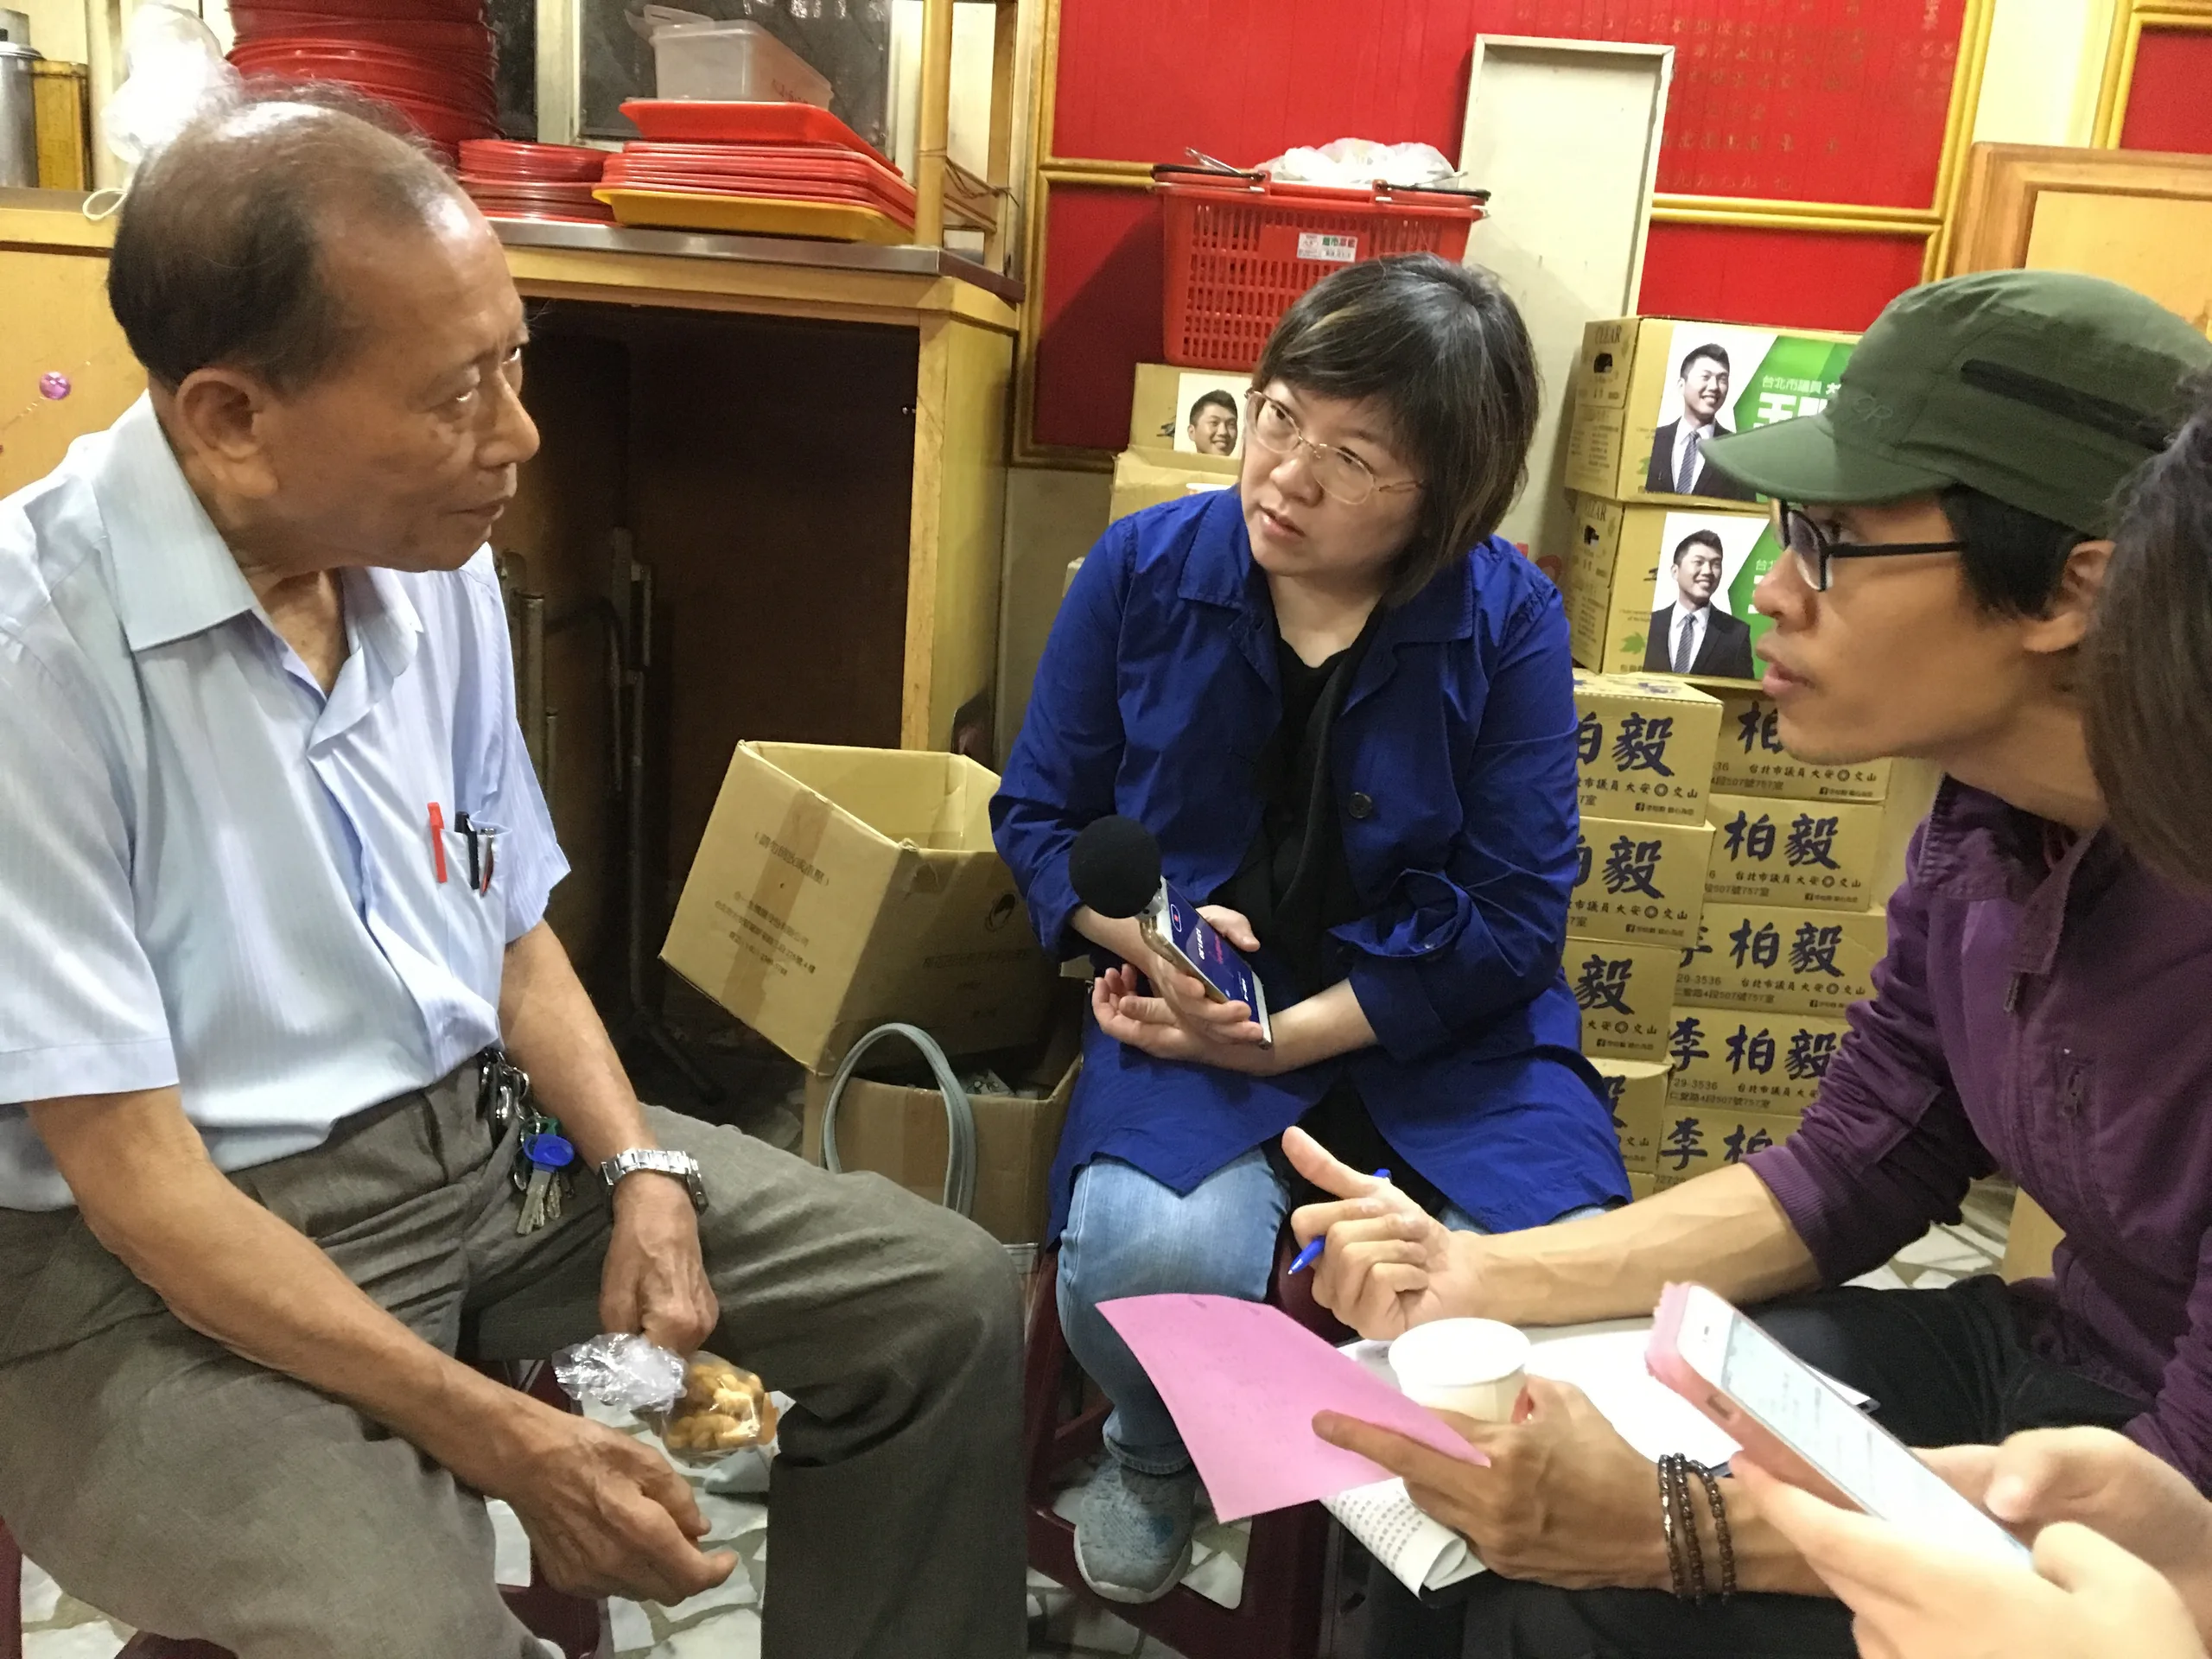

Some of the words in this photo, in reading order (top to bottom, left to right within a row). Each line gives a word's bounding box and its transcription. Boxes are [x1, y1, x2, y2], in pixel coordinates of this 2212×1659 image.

[1594, 324, 1622, 345] CLEAR
[1753, 391, 1827, 428] 王
[1749, 763, 1806, 778] 台北市議員
[1854, 771, 1878, 782] 文山
[1625, 781, 1651, 795] 大安
[1673, 785, 1699, 799] 文山
[1723, 810, 1842, 870] 柏毅
[1735, 870, 1791, 884] 台北市議員
[1840, 877, 1862, 889] 文山
[1616, 904, 1641, 916] 大安
[1662, 907, 1688, 920] 文山
[1573, 954, 1636, 1016] 毅
[1740, 977, 1796, 992] 台北市議員
[1843, 984, 1866, 995] 文山
[1634, 1023, 1657, 1035] 文山
[1669, 1016, 1837, 1081] 李柏毅
[1737, 1083, 1790, 1096] 台北市議員
[1660, 1117, 1774, 1171] 李柏
